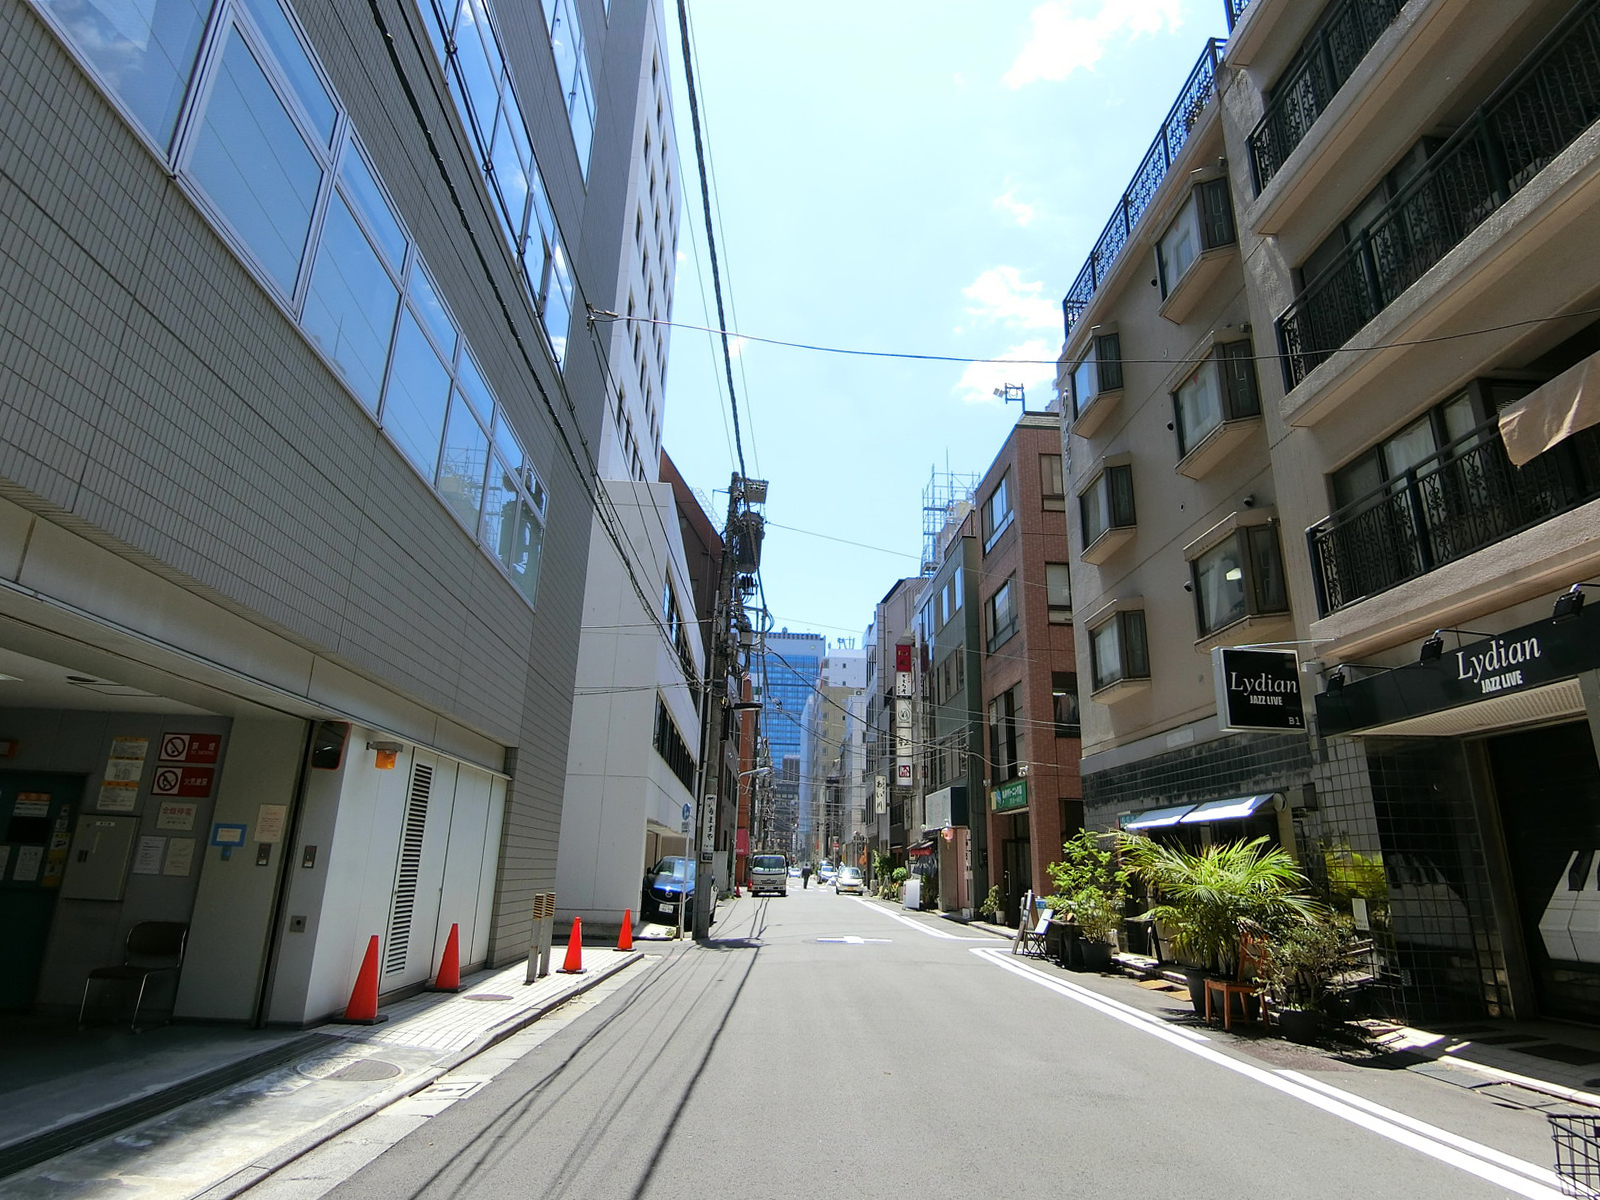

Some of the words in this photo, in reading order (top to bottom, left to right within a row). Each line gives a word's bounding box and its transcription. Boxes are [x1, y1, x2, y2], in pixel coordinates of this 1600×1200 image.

[1455, 637, 1542, 684] Lydian
[1230, 671, 1298, 696] Lydian
[1481, 675, 1502, 694] JAZZ
[1501, 669, 1524, 689] LIVE
[1249, 694, 1266, 705] JAZZ
[1266, 695, 1283, 706] LIVE
[1288, 716, 1301, 725] B1
